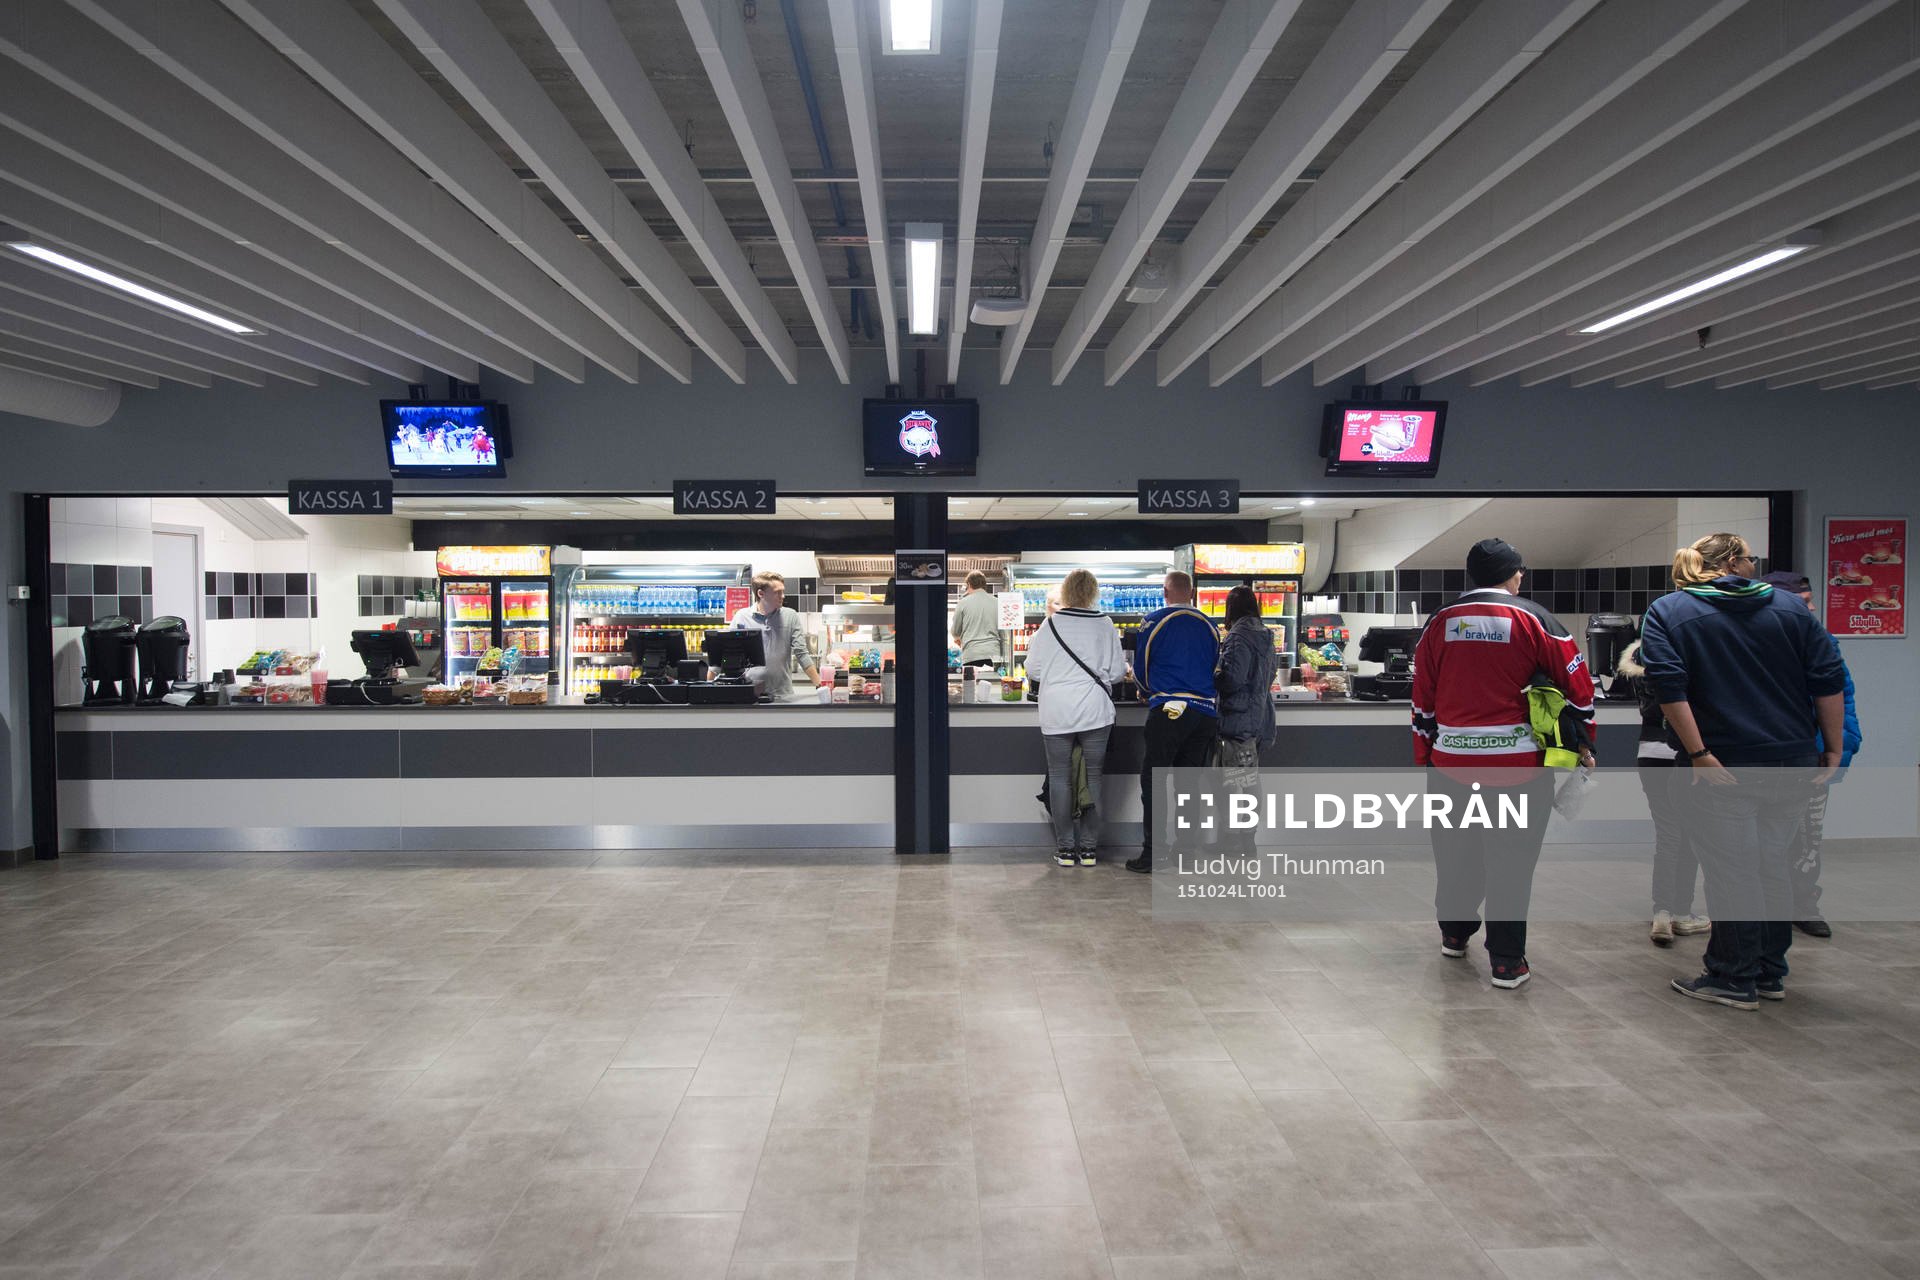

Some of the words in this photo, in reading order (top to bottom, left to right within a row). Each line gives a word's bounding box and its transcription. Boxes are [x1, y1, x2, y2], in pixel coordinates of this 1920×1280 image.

[298, 490, 365, 509] KASSA
[372, 490, 384, 509] 1
[682, 490, 749, 509] KASSA
[755, 490, 767, 508] 2
[1147, 489, 1213, 508] KASSA
[1218, 489, 1230, 508] 3
[1465, 630, 1503, 641] bravida
[1442, 734, 1518, 749] CASHBUDDY
